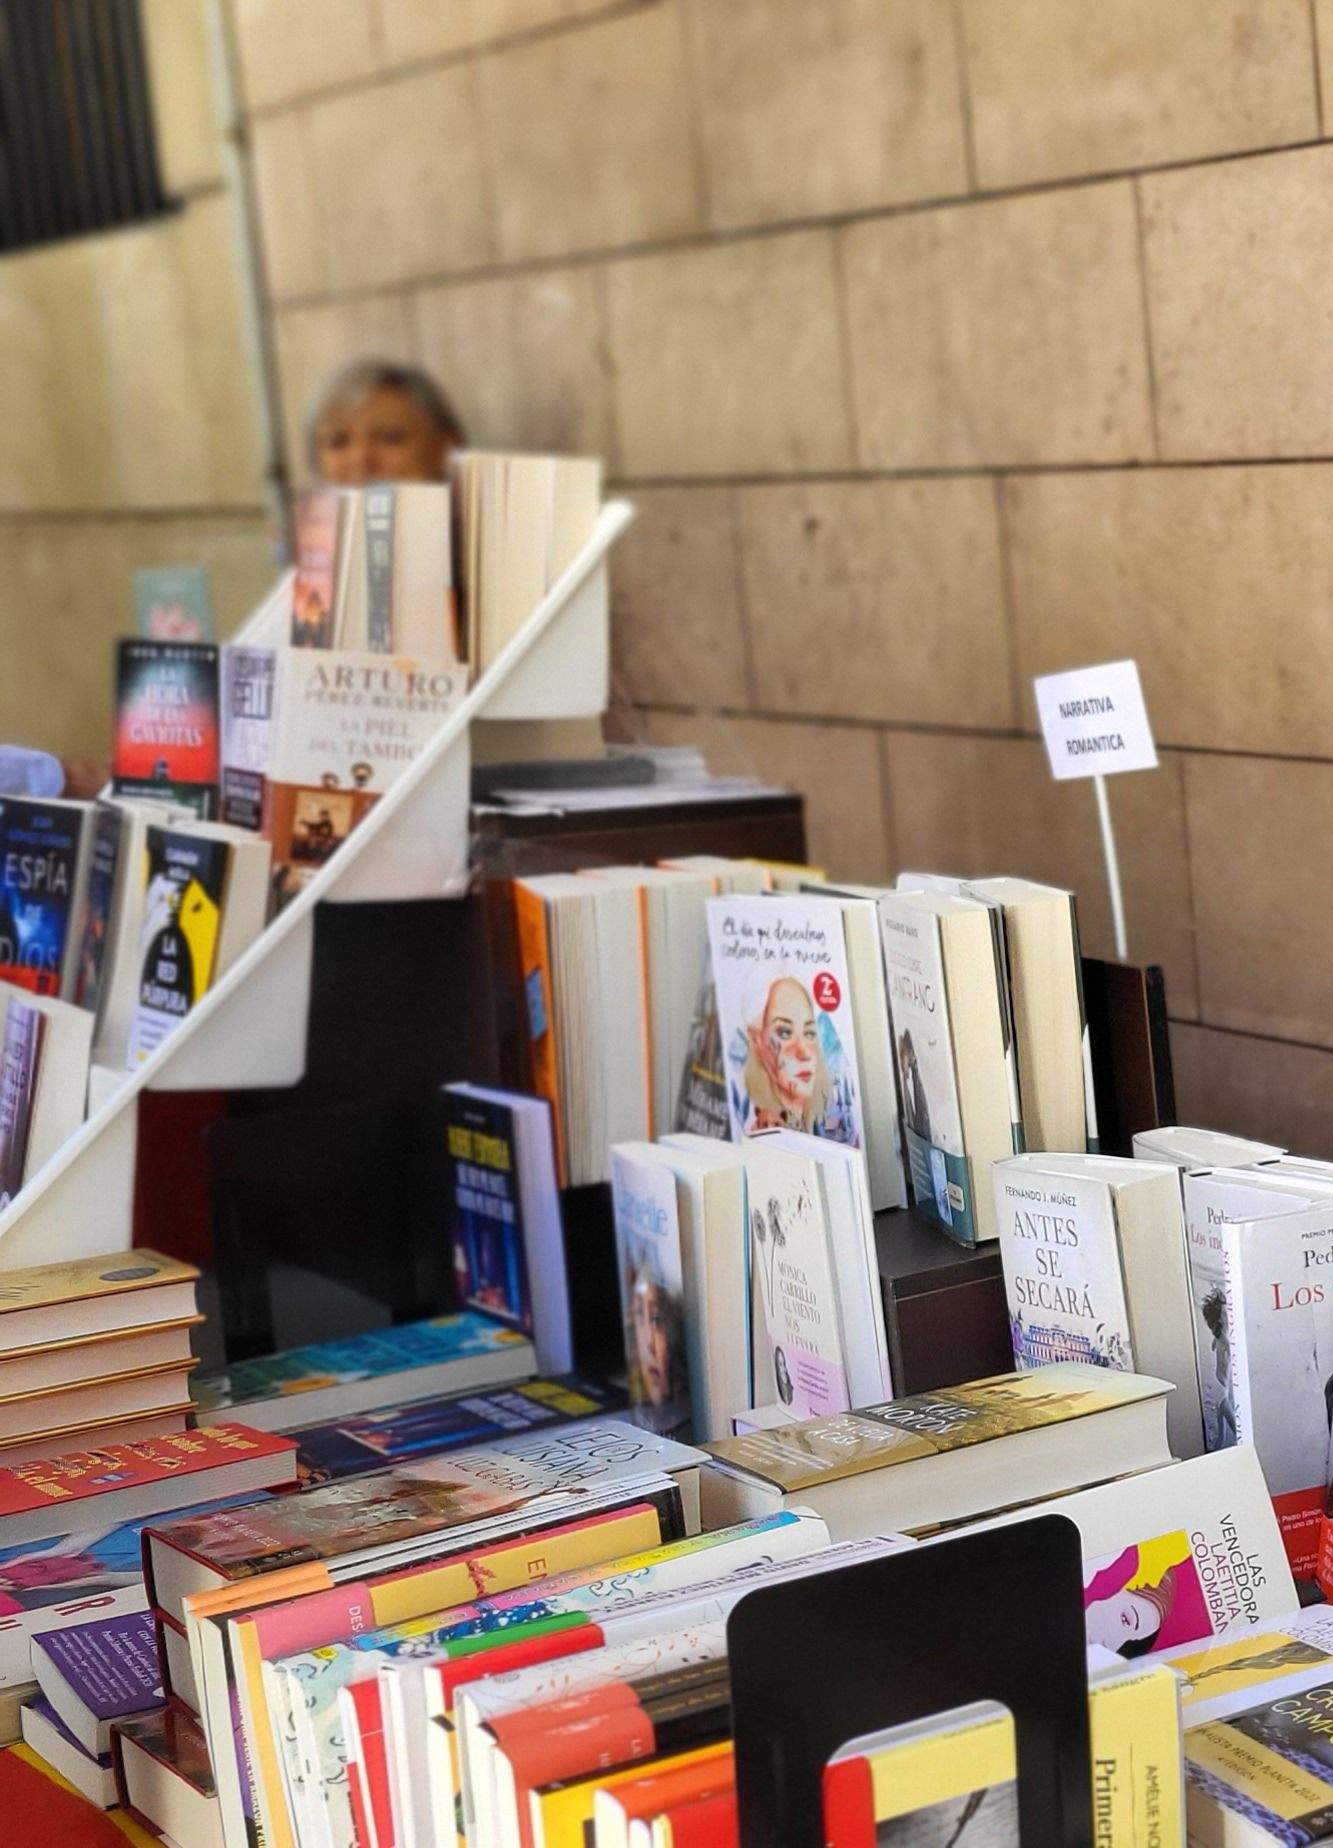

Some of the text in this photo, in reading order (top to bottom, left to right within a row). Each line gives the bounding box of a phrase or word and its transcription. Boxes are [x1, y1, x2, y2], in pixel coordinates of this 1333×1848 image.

[305, 665, 454, 698] ARTURO
[1059, 696, 1115, 719] NARRATIVA
[4, 852, 68, 892] ESPÍA
[163, 938, 178, 957] LA
[1005, 1184, 1041, 1203] FERNANDO
[1013, 1210, 1079, 1248] ANTES
[1301, 1229, 1326, 1240] PREMIO
[1035, 1248, 1063, 1278] SE
[780, 1281, 817, 1305] CARRILLO
[1014, 1275, 1095, 1319] SECARÁ
[1271, 1281, 1325, 1311] Los
[864, 1404, 967, 1435] MORTON
[919, 1402, 978, 1420] KATE
[1211, 1542, 1242, 1621] LAETITIA
[1219, 1514, 1260, 1625] VENCEDORA
[1247, 1553, 1267, 1588] LAS
[1146, 1765, 1162, 1819] AMÉLIE
